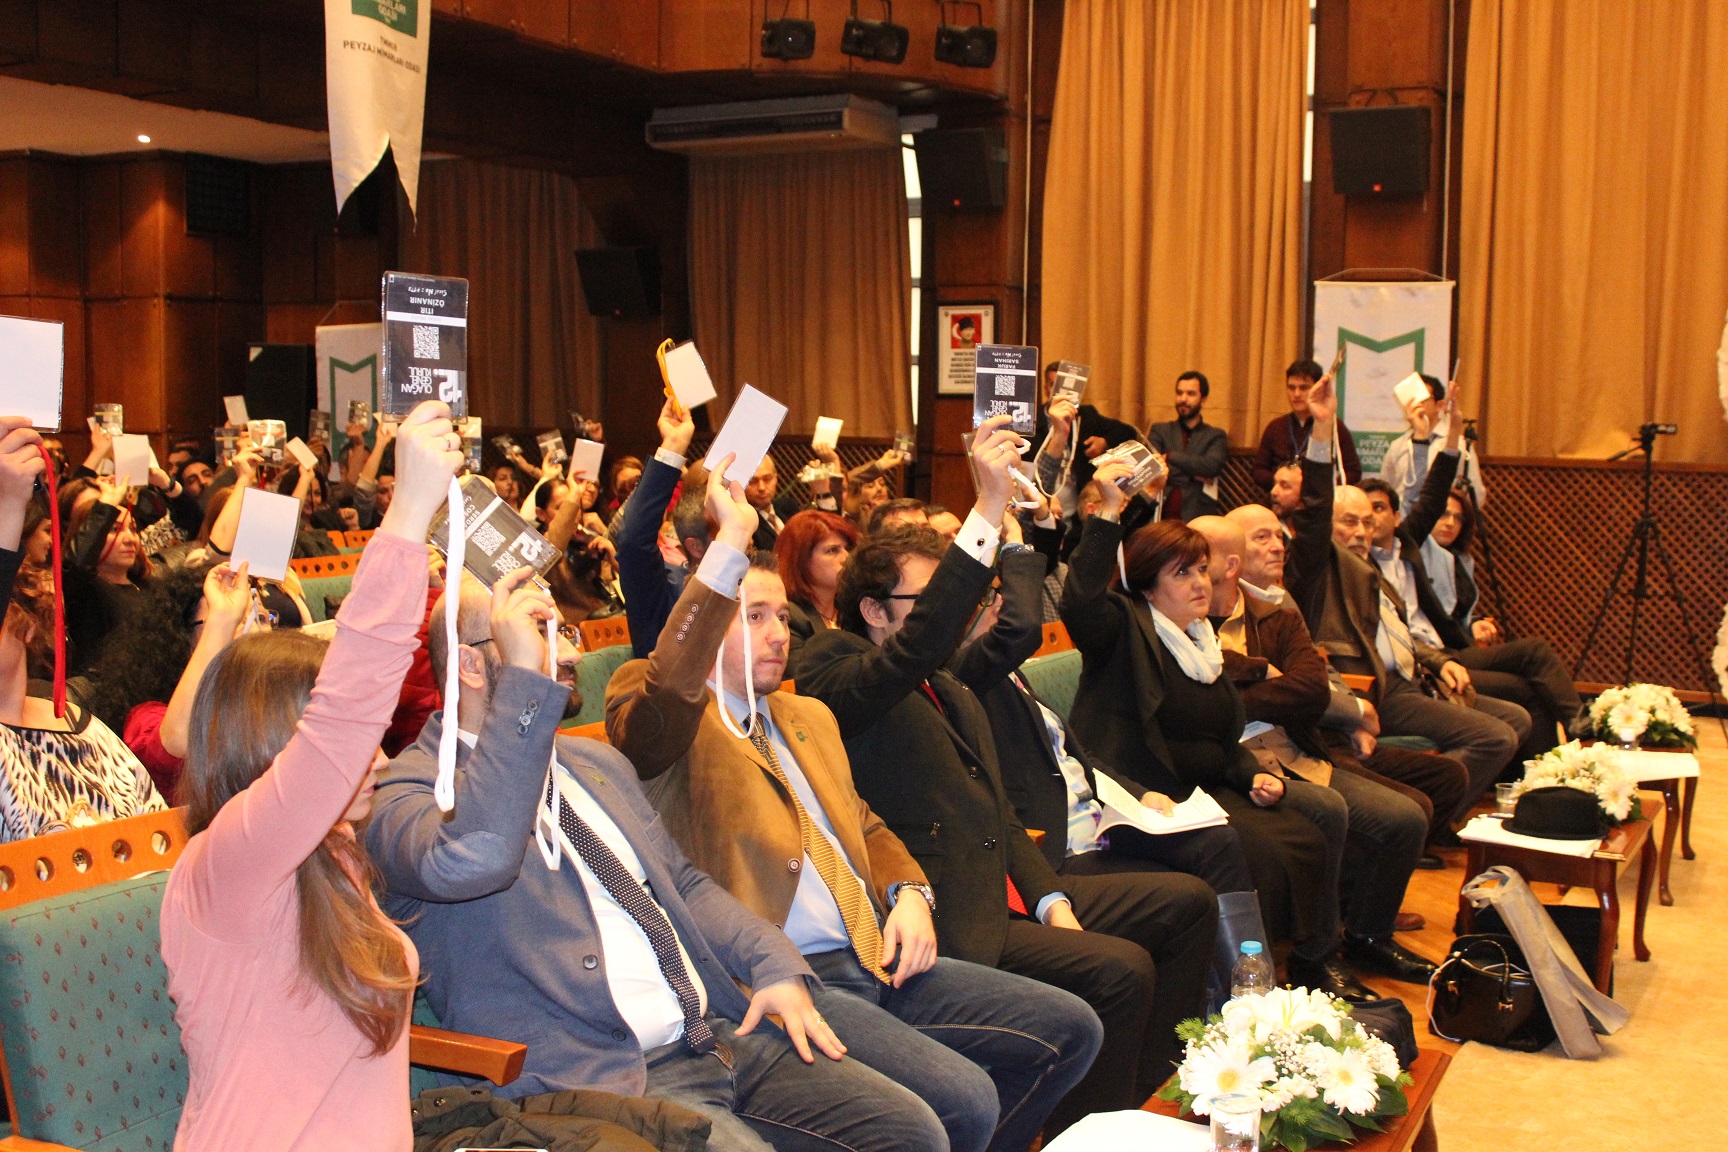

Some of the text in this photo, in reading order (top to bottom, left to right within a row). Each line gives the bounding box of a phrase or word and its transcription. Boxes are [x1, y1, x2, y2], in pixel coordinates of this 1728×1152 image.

[343, 40, 376, 53] PEYZAJ
[409, 296, 445, 308] ÖZİNANIR
[400, 383, 433, 395] OLAĞAN
[1360, 439, 1391, 448] PEYZA
[1361, 456, 1383, 465] ODA
